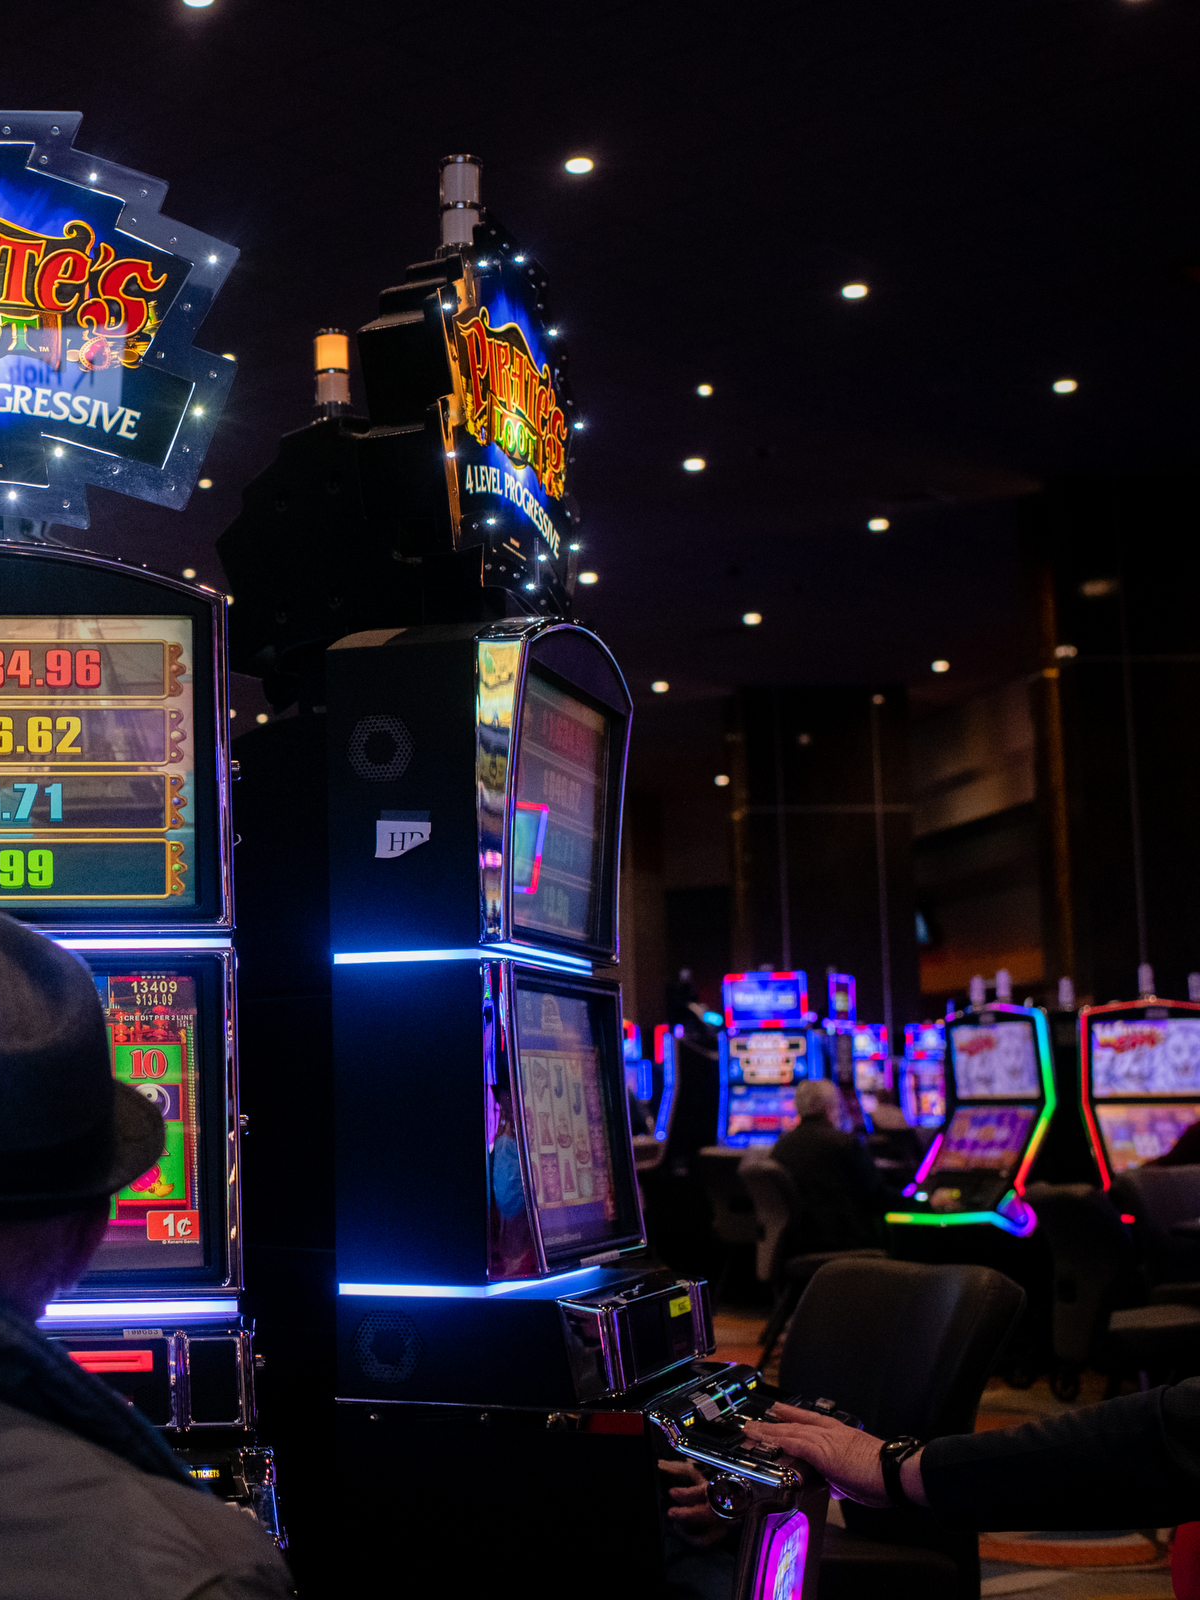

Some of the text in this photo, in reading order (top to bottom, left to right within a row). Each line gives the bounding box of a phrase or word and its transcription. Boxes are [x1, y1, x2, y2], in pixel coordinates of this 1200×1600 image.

[456, 317, 567, 473] PIRATE'S
[494, 406, 537, 470] LOOT
[465, 464, 474, 494] 4
[474, 465, 503, 496] LEVEL
[504, 472, 561, 559] PROGRESSIVE
[131, 981, 178, 993] 13409
[136, 993, 173, 1006] $134.09
[129, 1048, 168, 1079] 10
[163, 1213, 192, 1237] 1¢
[197, 1470, 220, 1478] TICKETS
